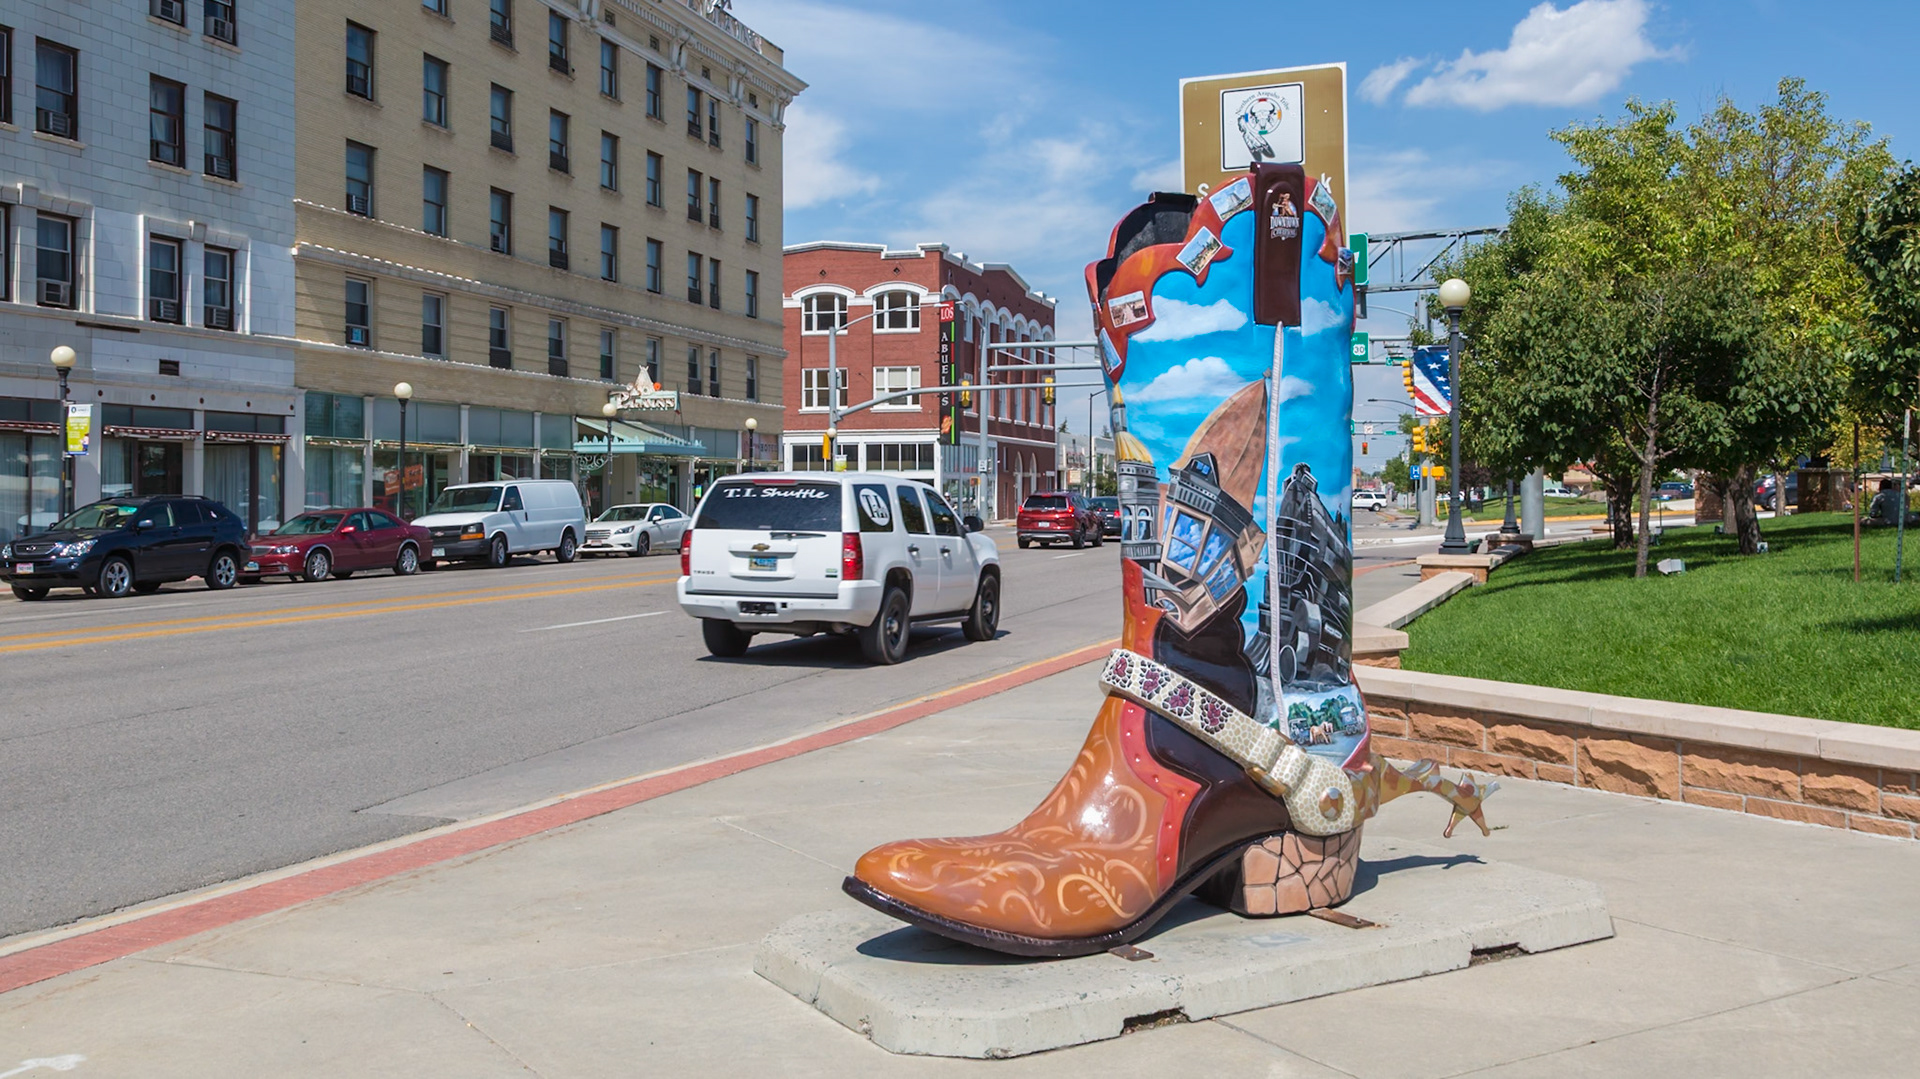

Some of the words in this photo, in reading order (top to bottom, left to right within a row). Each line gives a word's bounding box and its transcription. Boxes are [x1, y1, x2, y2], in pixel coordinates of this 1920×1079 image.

[1235, 93, 1257, 115] Northern
[941, 307, 954, 319] LOS
[1354, 346, 1365, 354] 30
[1412, 467, 1420, 475] H
[760, 488, 829, 499] Shuttle
